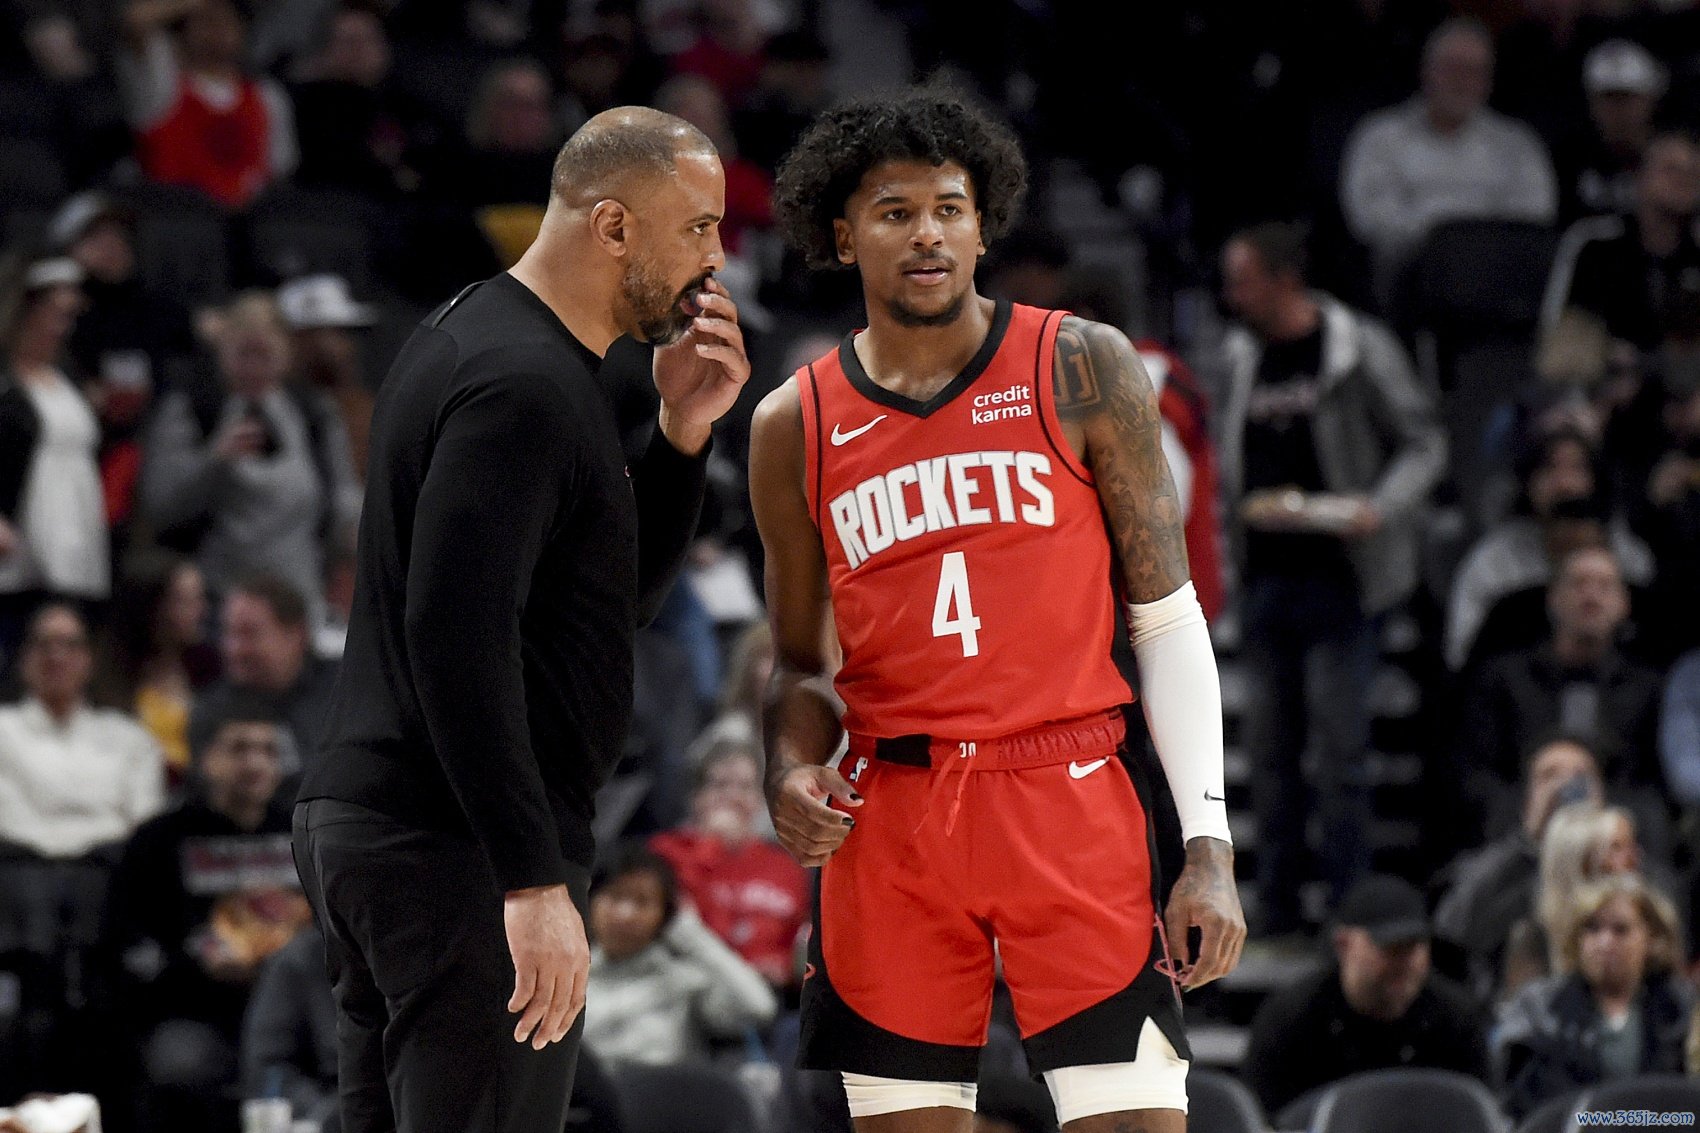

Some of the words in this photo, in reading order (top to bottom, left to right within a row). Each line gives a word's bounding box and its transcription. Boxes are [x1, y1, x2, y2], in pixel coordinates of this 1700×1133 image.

[971, 404, 1032, 425] karma
[973, 385, 1031, 407] credit
[828, 450, 1055, 570] ROCKETS
[932, 551, 982, 658] 4
